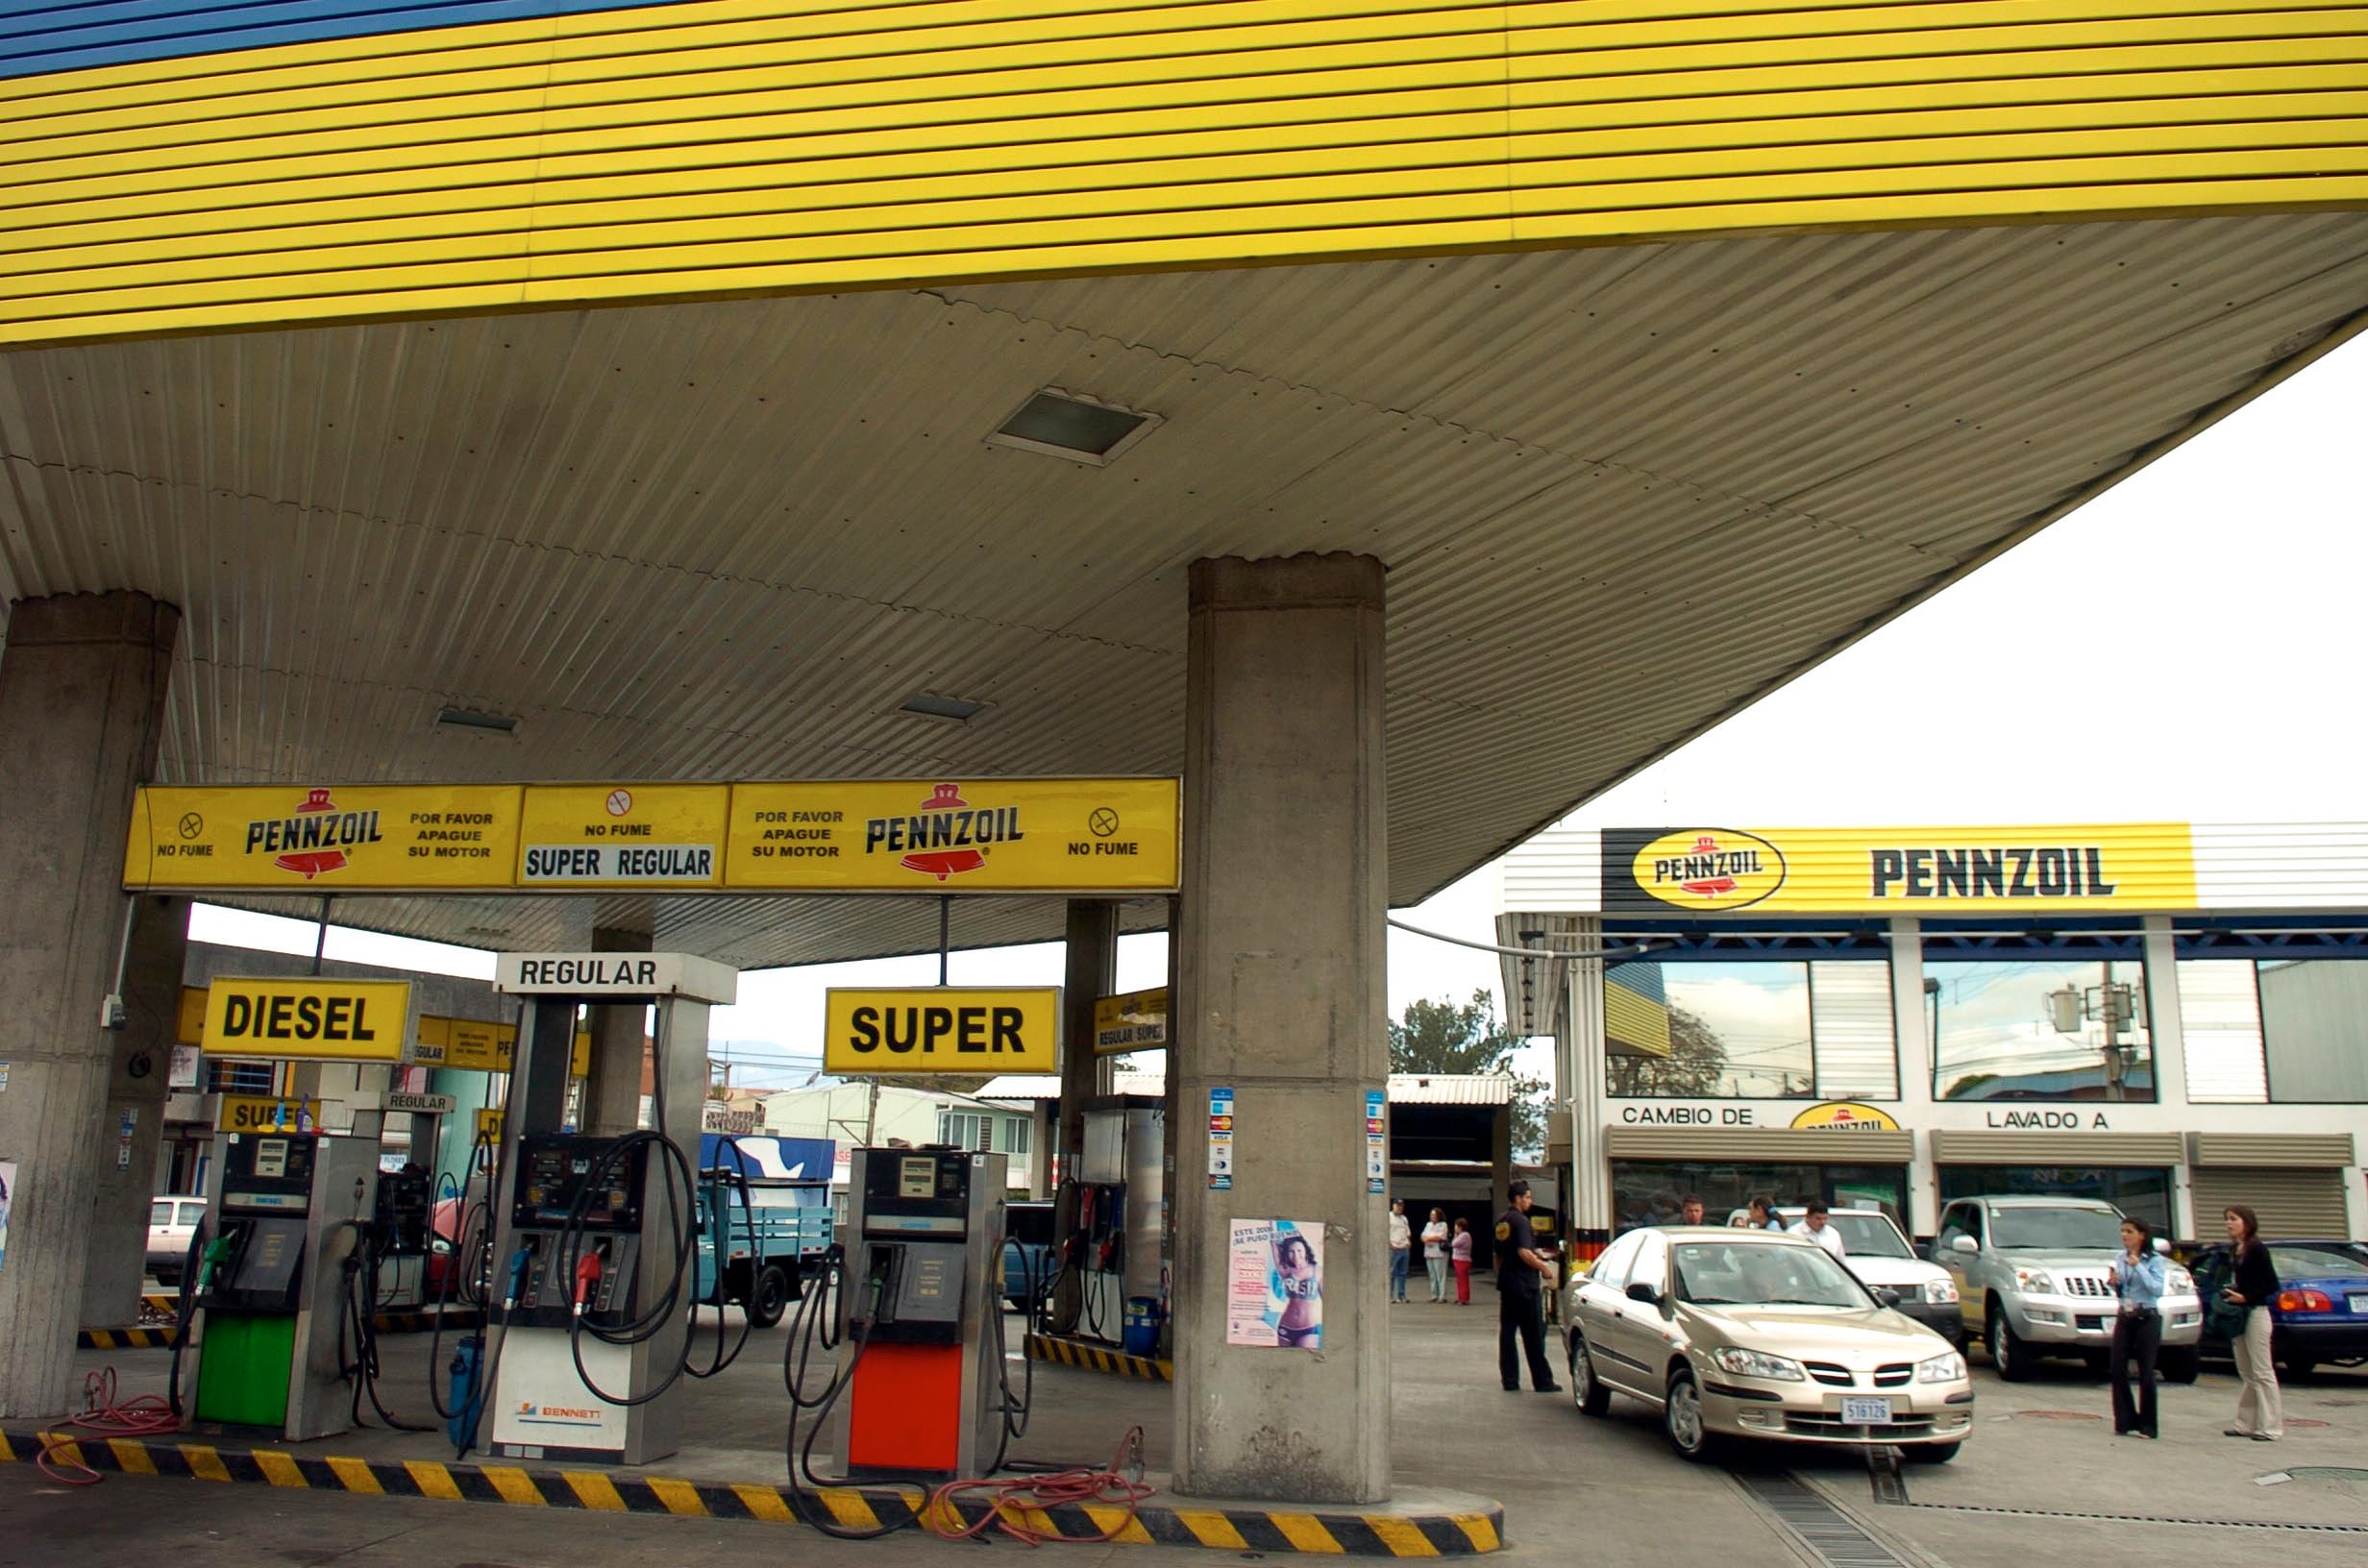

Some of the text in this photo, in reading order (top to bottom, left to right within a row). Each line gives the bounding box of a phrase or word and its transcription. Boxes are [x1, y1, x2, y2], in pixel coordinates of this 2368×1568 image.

[409, 813, 494, 825] POR FAVOR
[754, 810, 844, 823] POR FAVOR
[245, 810, 382, 854] PENNZOIL
[417, 829, 482, 842] APAGUE
[584, 823, 652, 837] NO FUME
[763, 828, 832, 841] APAGUE
[865, 806, 1024, 853] PENNZOIL
[157, 844, 213, 857] NO FUME
[408, 846, 491, 859] SU MOTOR
[752, 845, 840, 858] SU MOTOR
[1068, 842, 1139, 856] NO FUME
[526, 848, 710, 876] SUPER REGULAR
[1654, 848, 1764, 883] PENNZOIL
[1870, 848, 2117, 897] PENNZOIL
[519, 960, 656, 986] REGULAR
[222, 993, 375, 1041] DIESEL
[849, 1006, 1025, 1054] SUPER
[389, 1094, 447, 1110] REGULAR
[234, 1104, 299, 1127] SUPE
[1622, 1106, 1754, 1126] CAMBIO DE
[1986, 1111, 2109, 1130] LAVADO A
[542, 1407, 600, 1418] BENNETT
